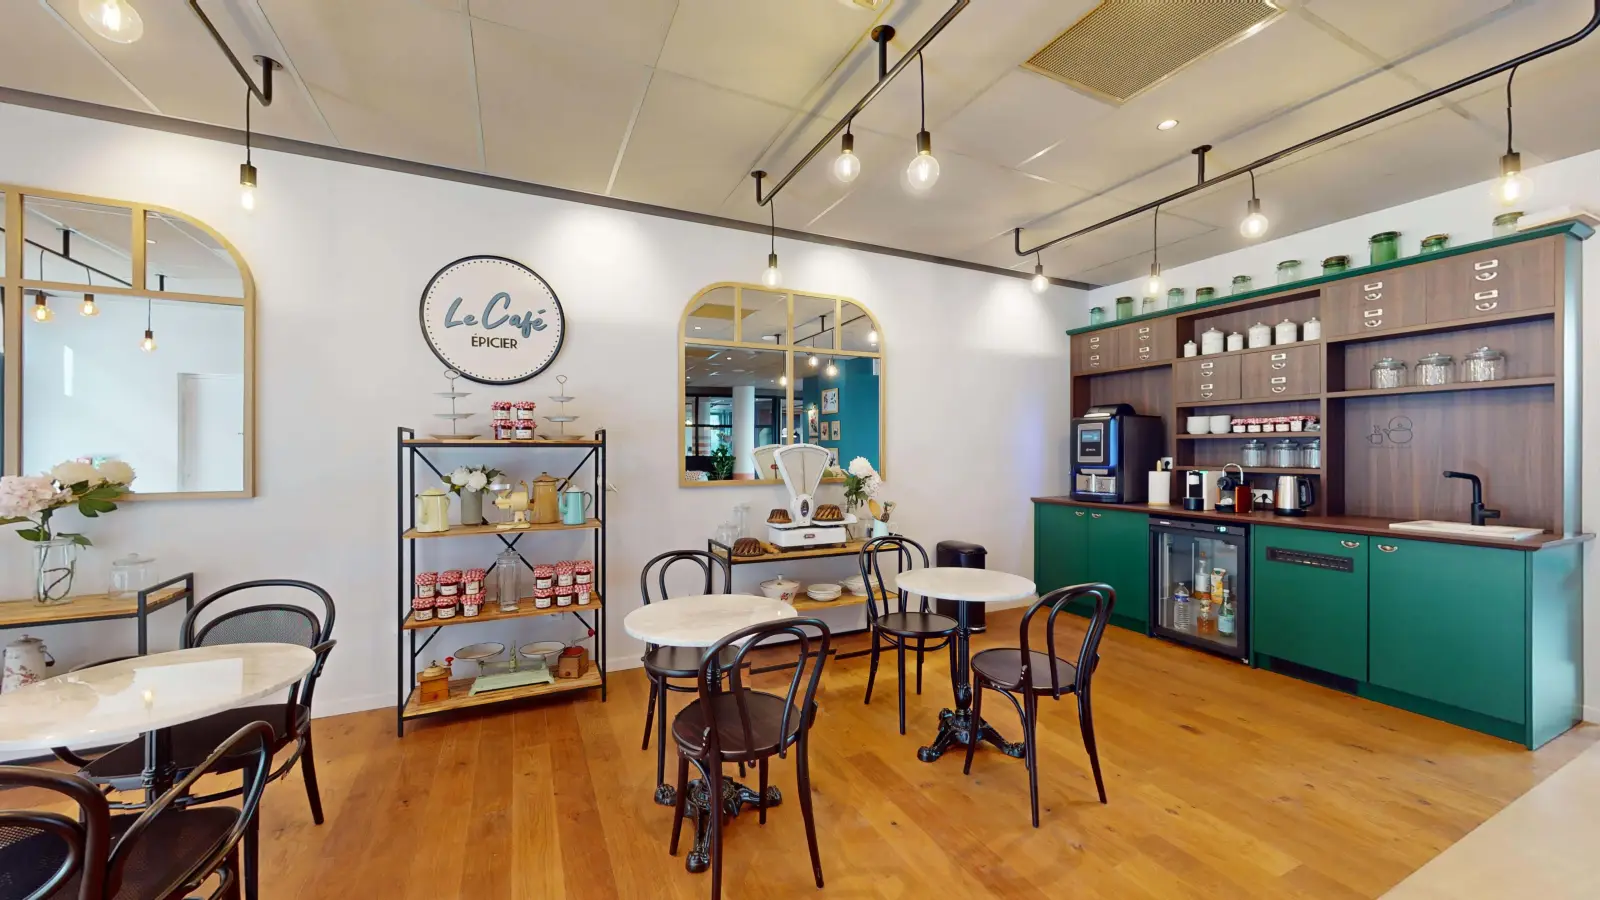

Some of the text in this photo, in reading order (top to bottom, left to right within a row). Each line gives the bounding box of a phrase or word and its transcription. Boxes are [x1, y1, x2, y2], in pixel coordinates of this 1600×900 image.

[445, 292, 548, 338] Le Café
[471, 333, 518, 349] ÉPICIER
